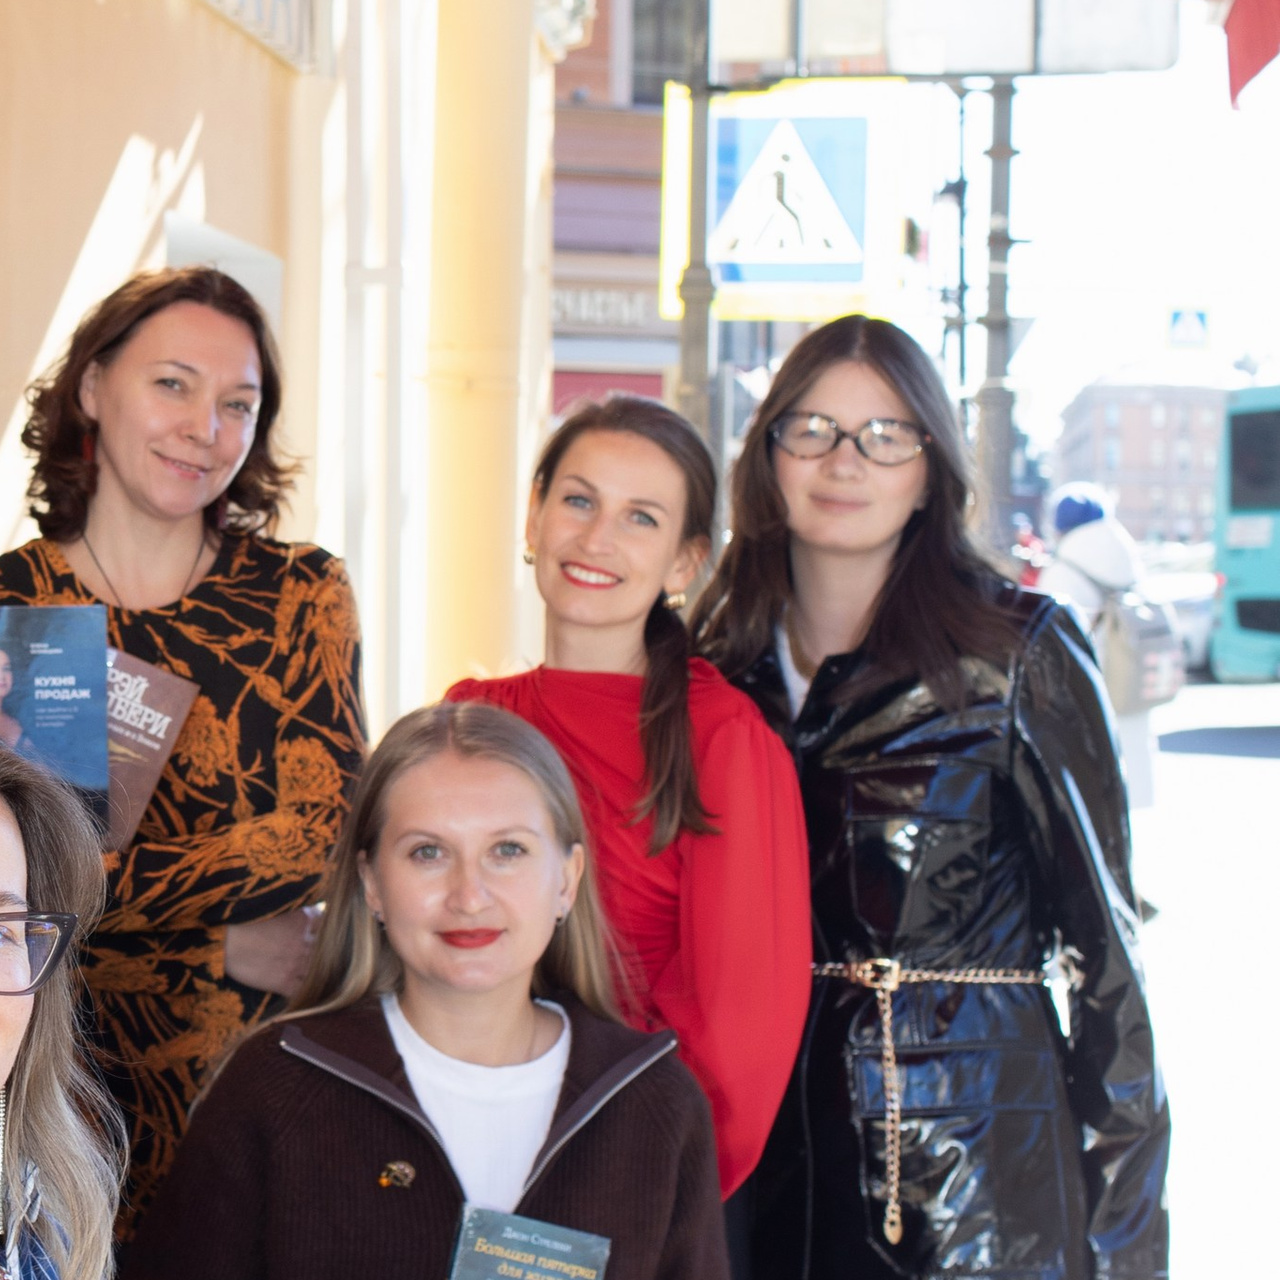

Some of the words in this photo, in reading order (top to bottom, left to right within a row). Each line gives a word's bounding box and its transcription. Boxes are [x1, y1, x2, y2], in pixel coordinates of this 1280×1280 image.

[34, 676, 76, 687] КУХНЯ
[34, 689, 91, 700] ПРОДАЖ
[474, 1237, 536, 1265] Большая
[497, 1260, 523, 1279] для
